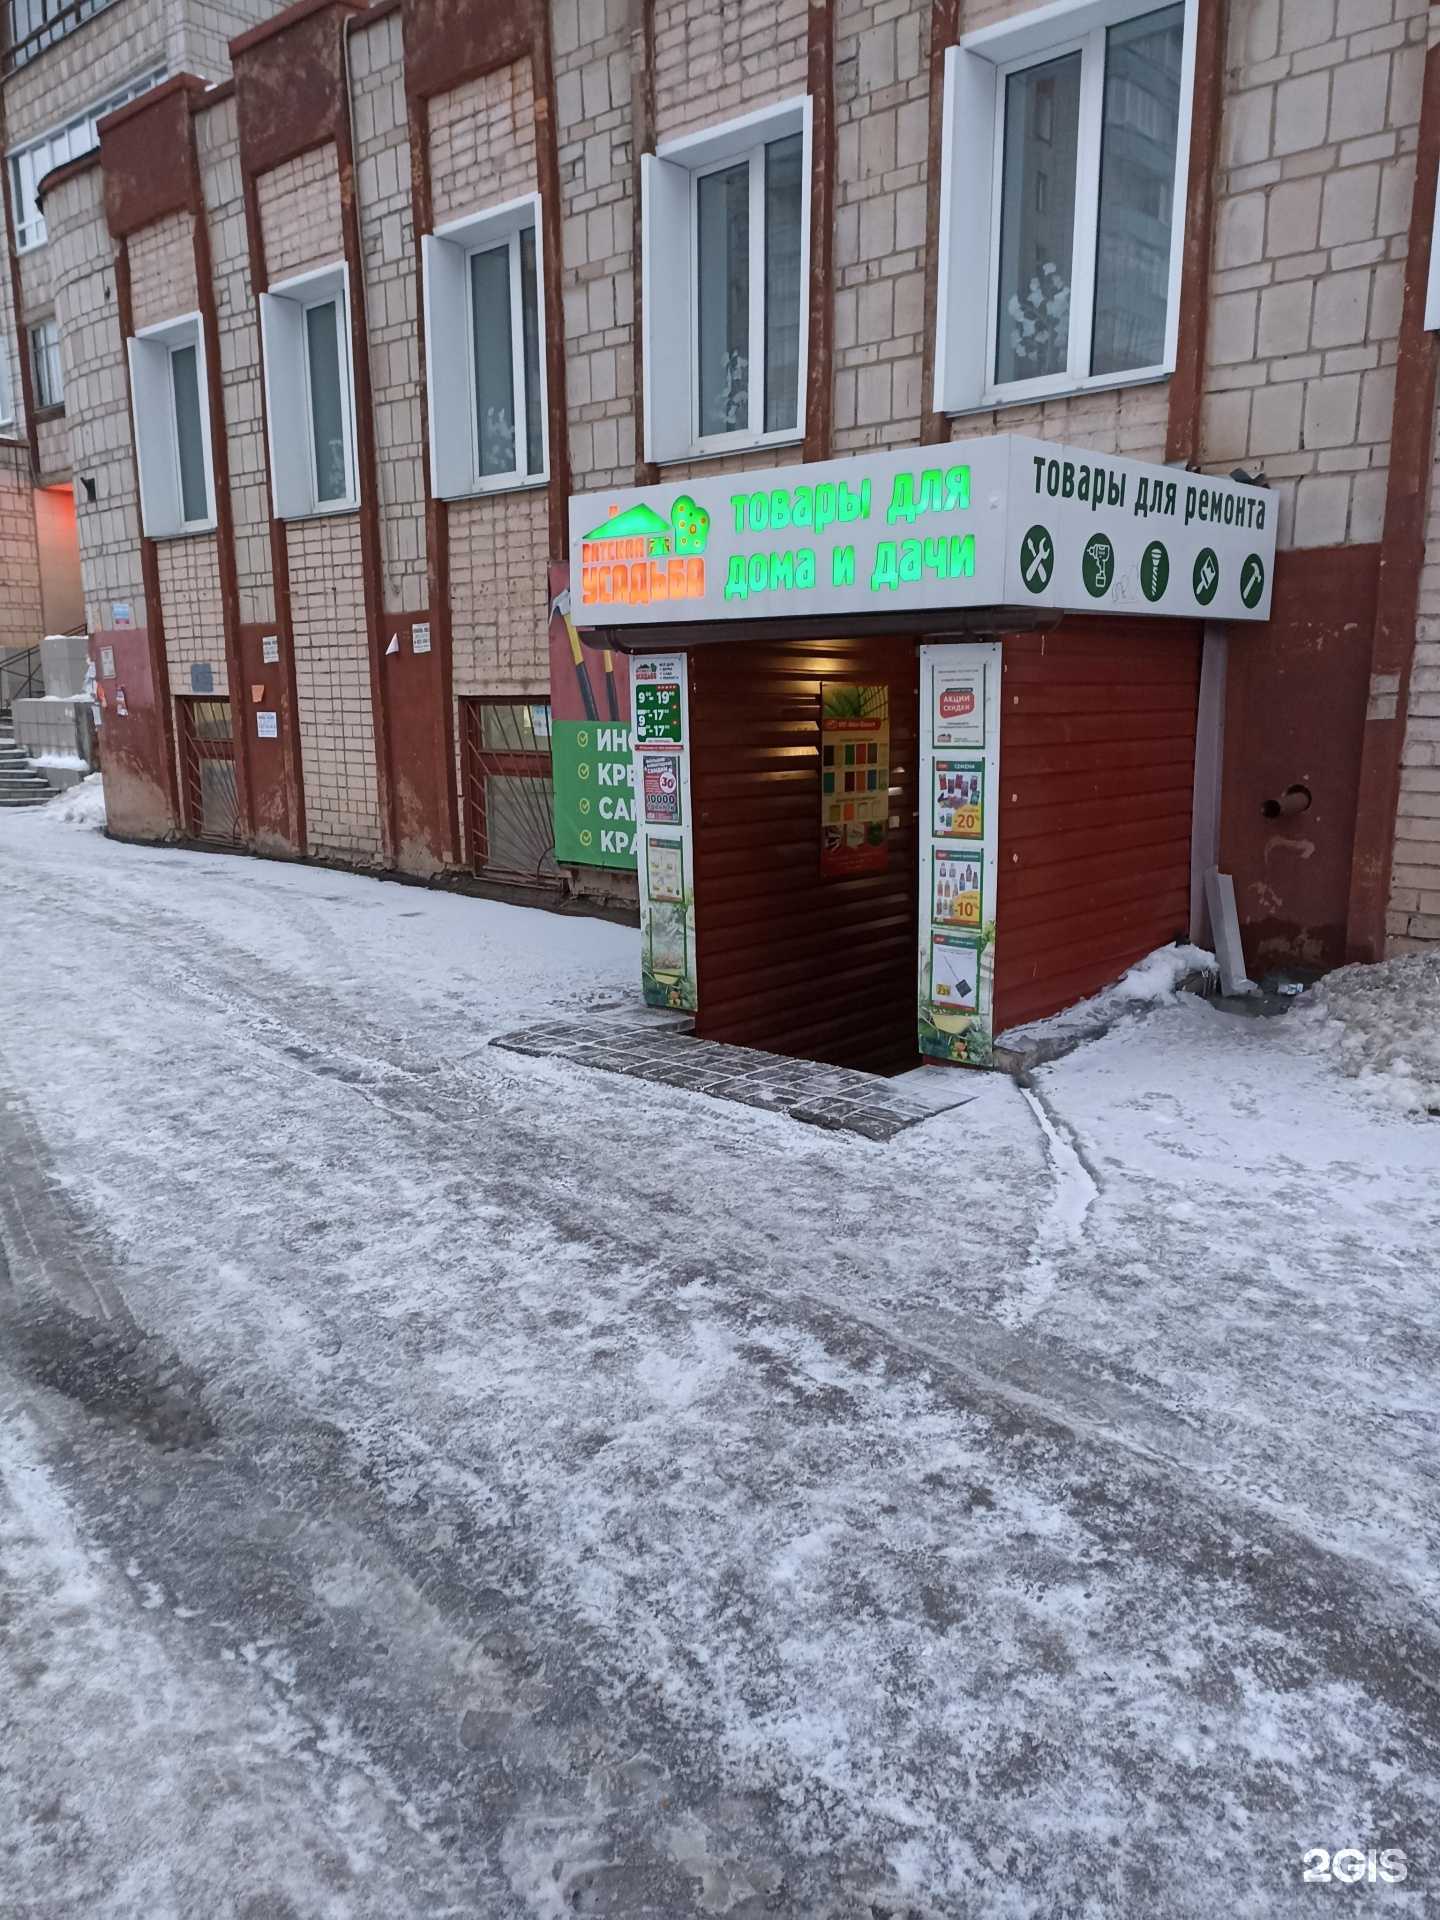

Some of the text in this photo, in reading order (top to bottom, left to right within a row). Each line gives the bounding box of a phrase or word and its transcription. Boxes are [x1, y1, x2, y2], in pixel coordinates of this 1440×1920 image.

[887, 465, 971, 525] для
[1033, 456, 1266, 530] товары для ремонта
[582, 557, 705, 606] УСАДЬБА
[724, 534, 975, 601] дома и дачи
